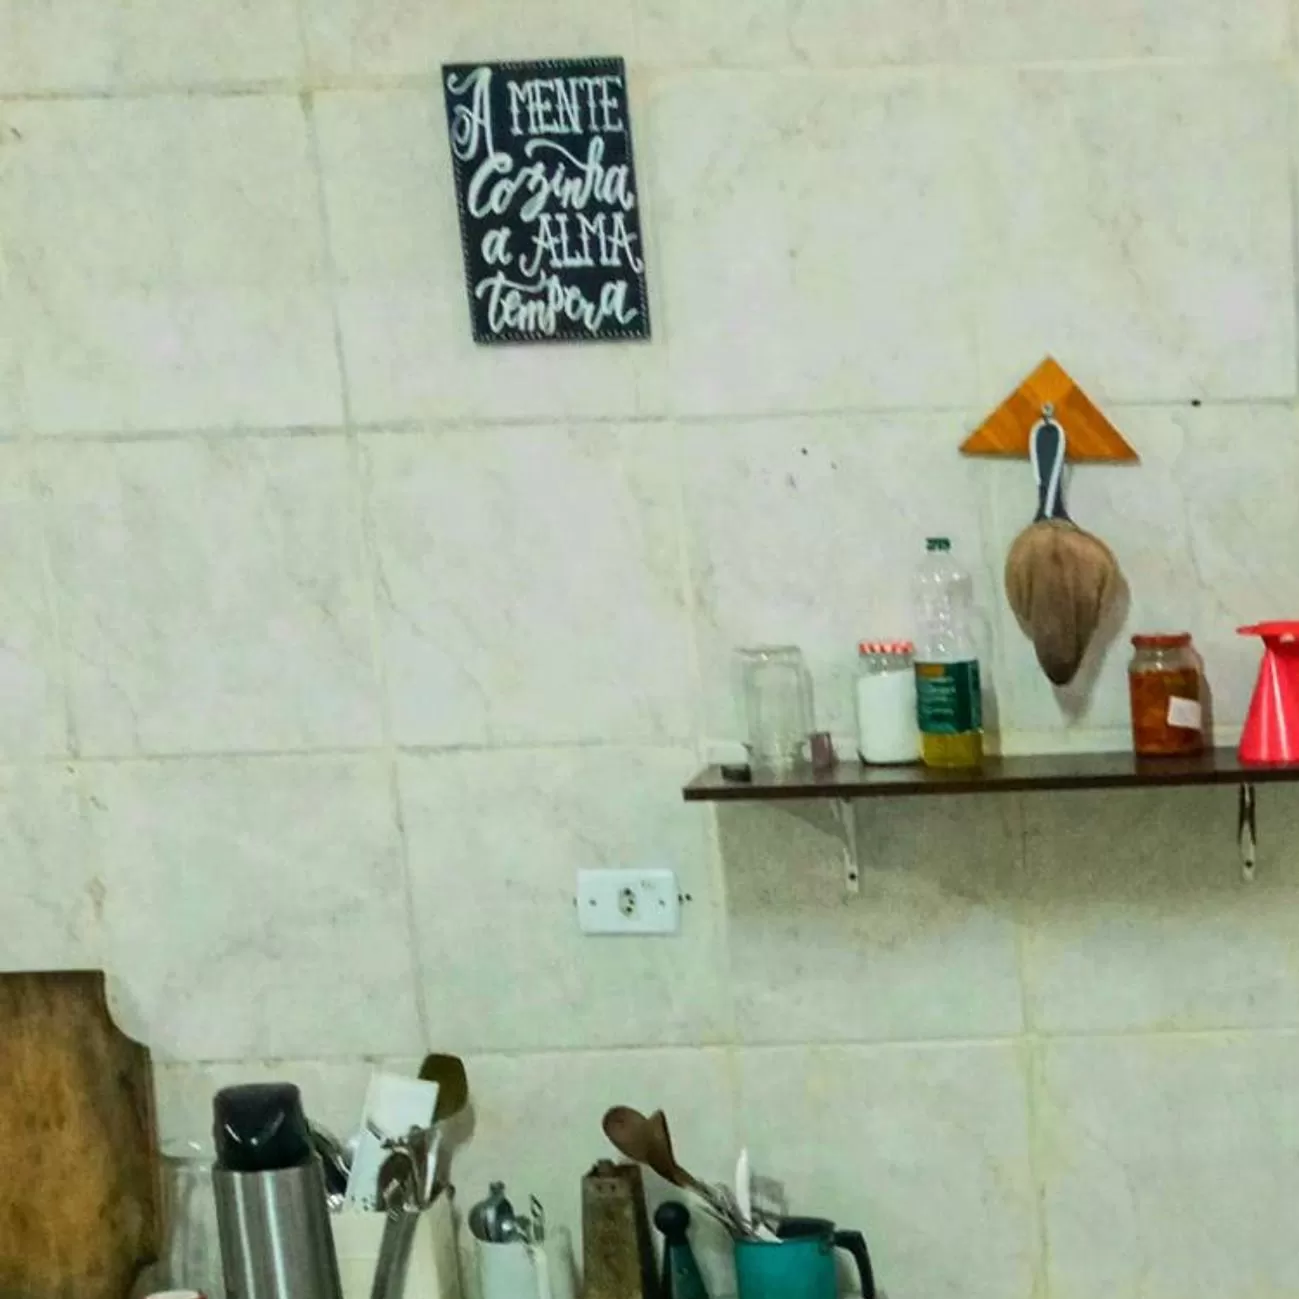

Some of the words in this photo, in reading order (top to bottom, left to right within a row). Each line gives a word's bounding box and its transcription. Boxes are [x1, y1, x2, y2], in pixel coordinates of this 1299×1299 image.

[448, 67, 493, 160] A
[507, 76, 623, 135] MENTE
[519, 212, 643, 276] ALMA
